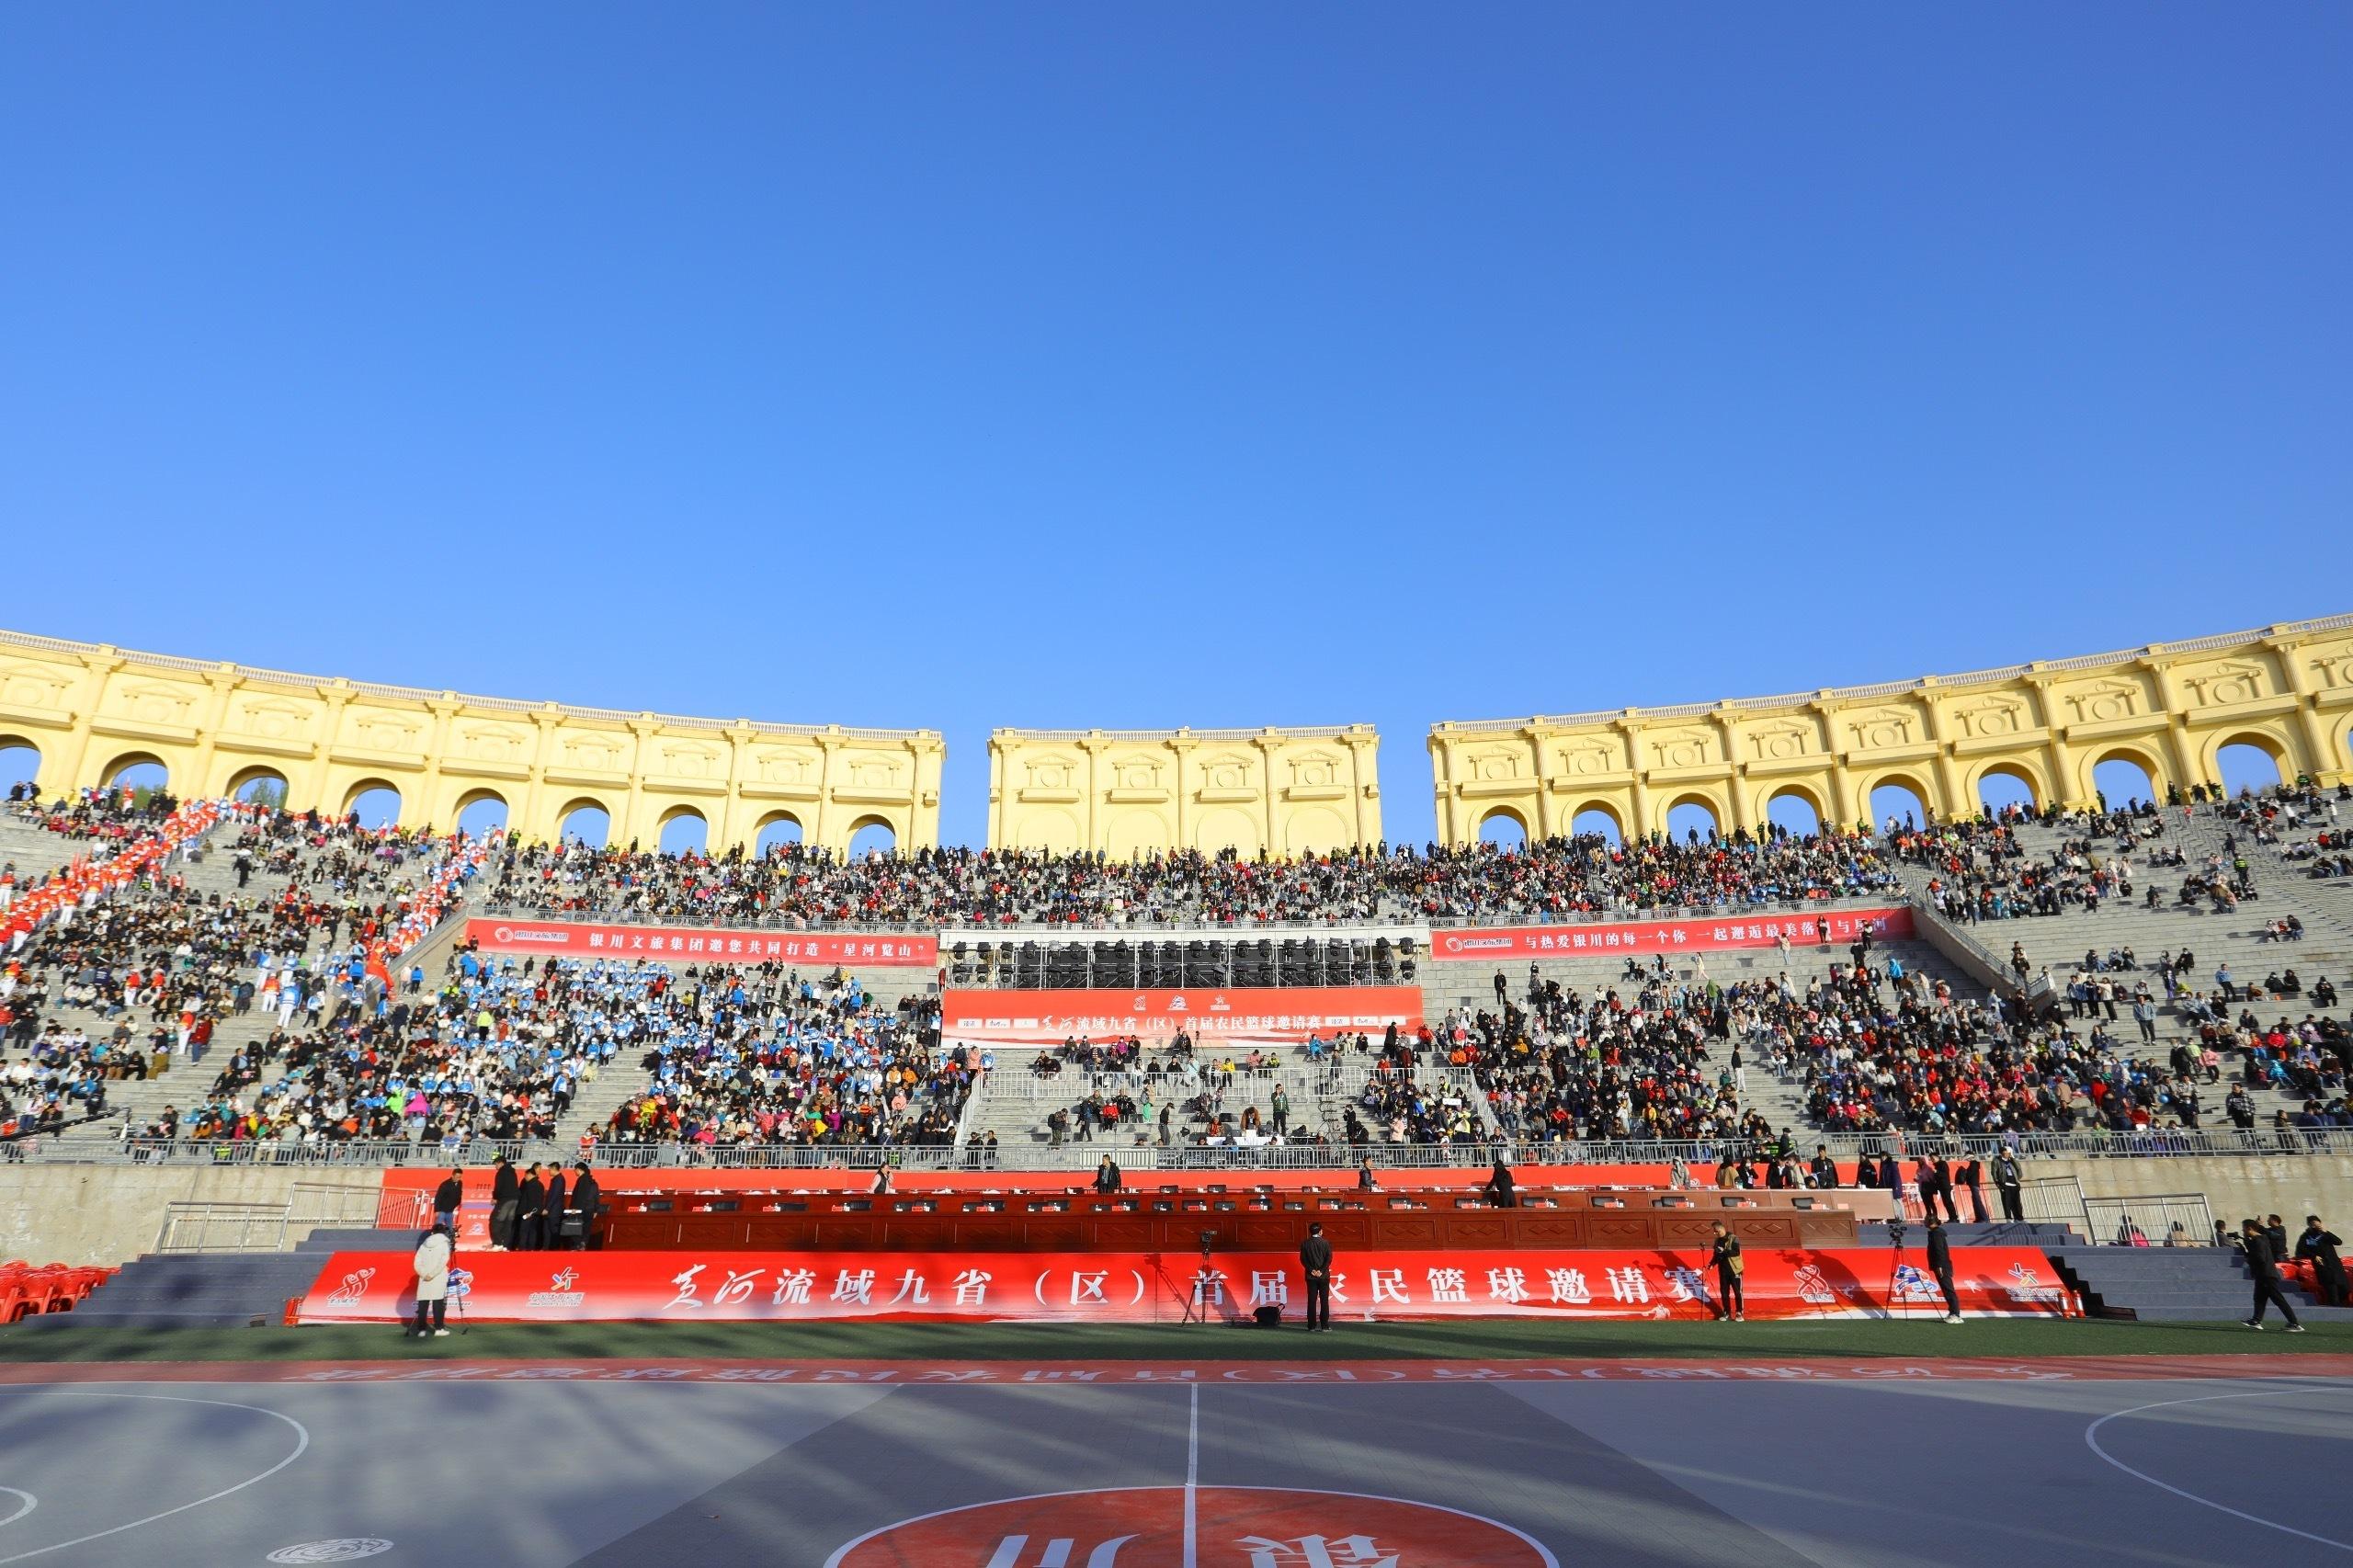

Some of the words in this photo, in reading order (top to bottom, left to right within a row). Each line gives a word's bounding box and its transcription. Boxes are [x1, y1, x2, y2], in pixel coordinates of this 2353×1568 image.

[1524, 927, 1687, 949] 与热爱银川的每一个你
[1696, 917, 1886, 942] 一起邂逅最美落与星河
